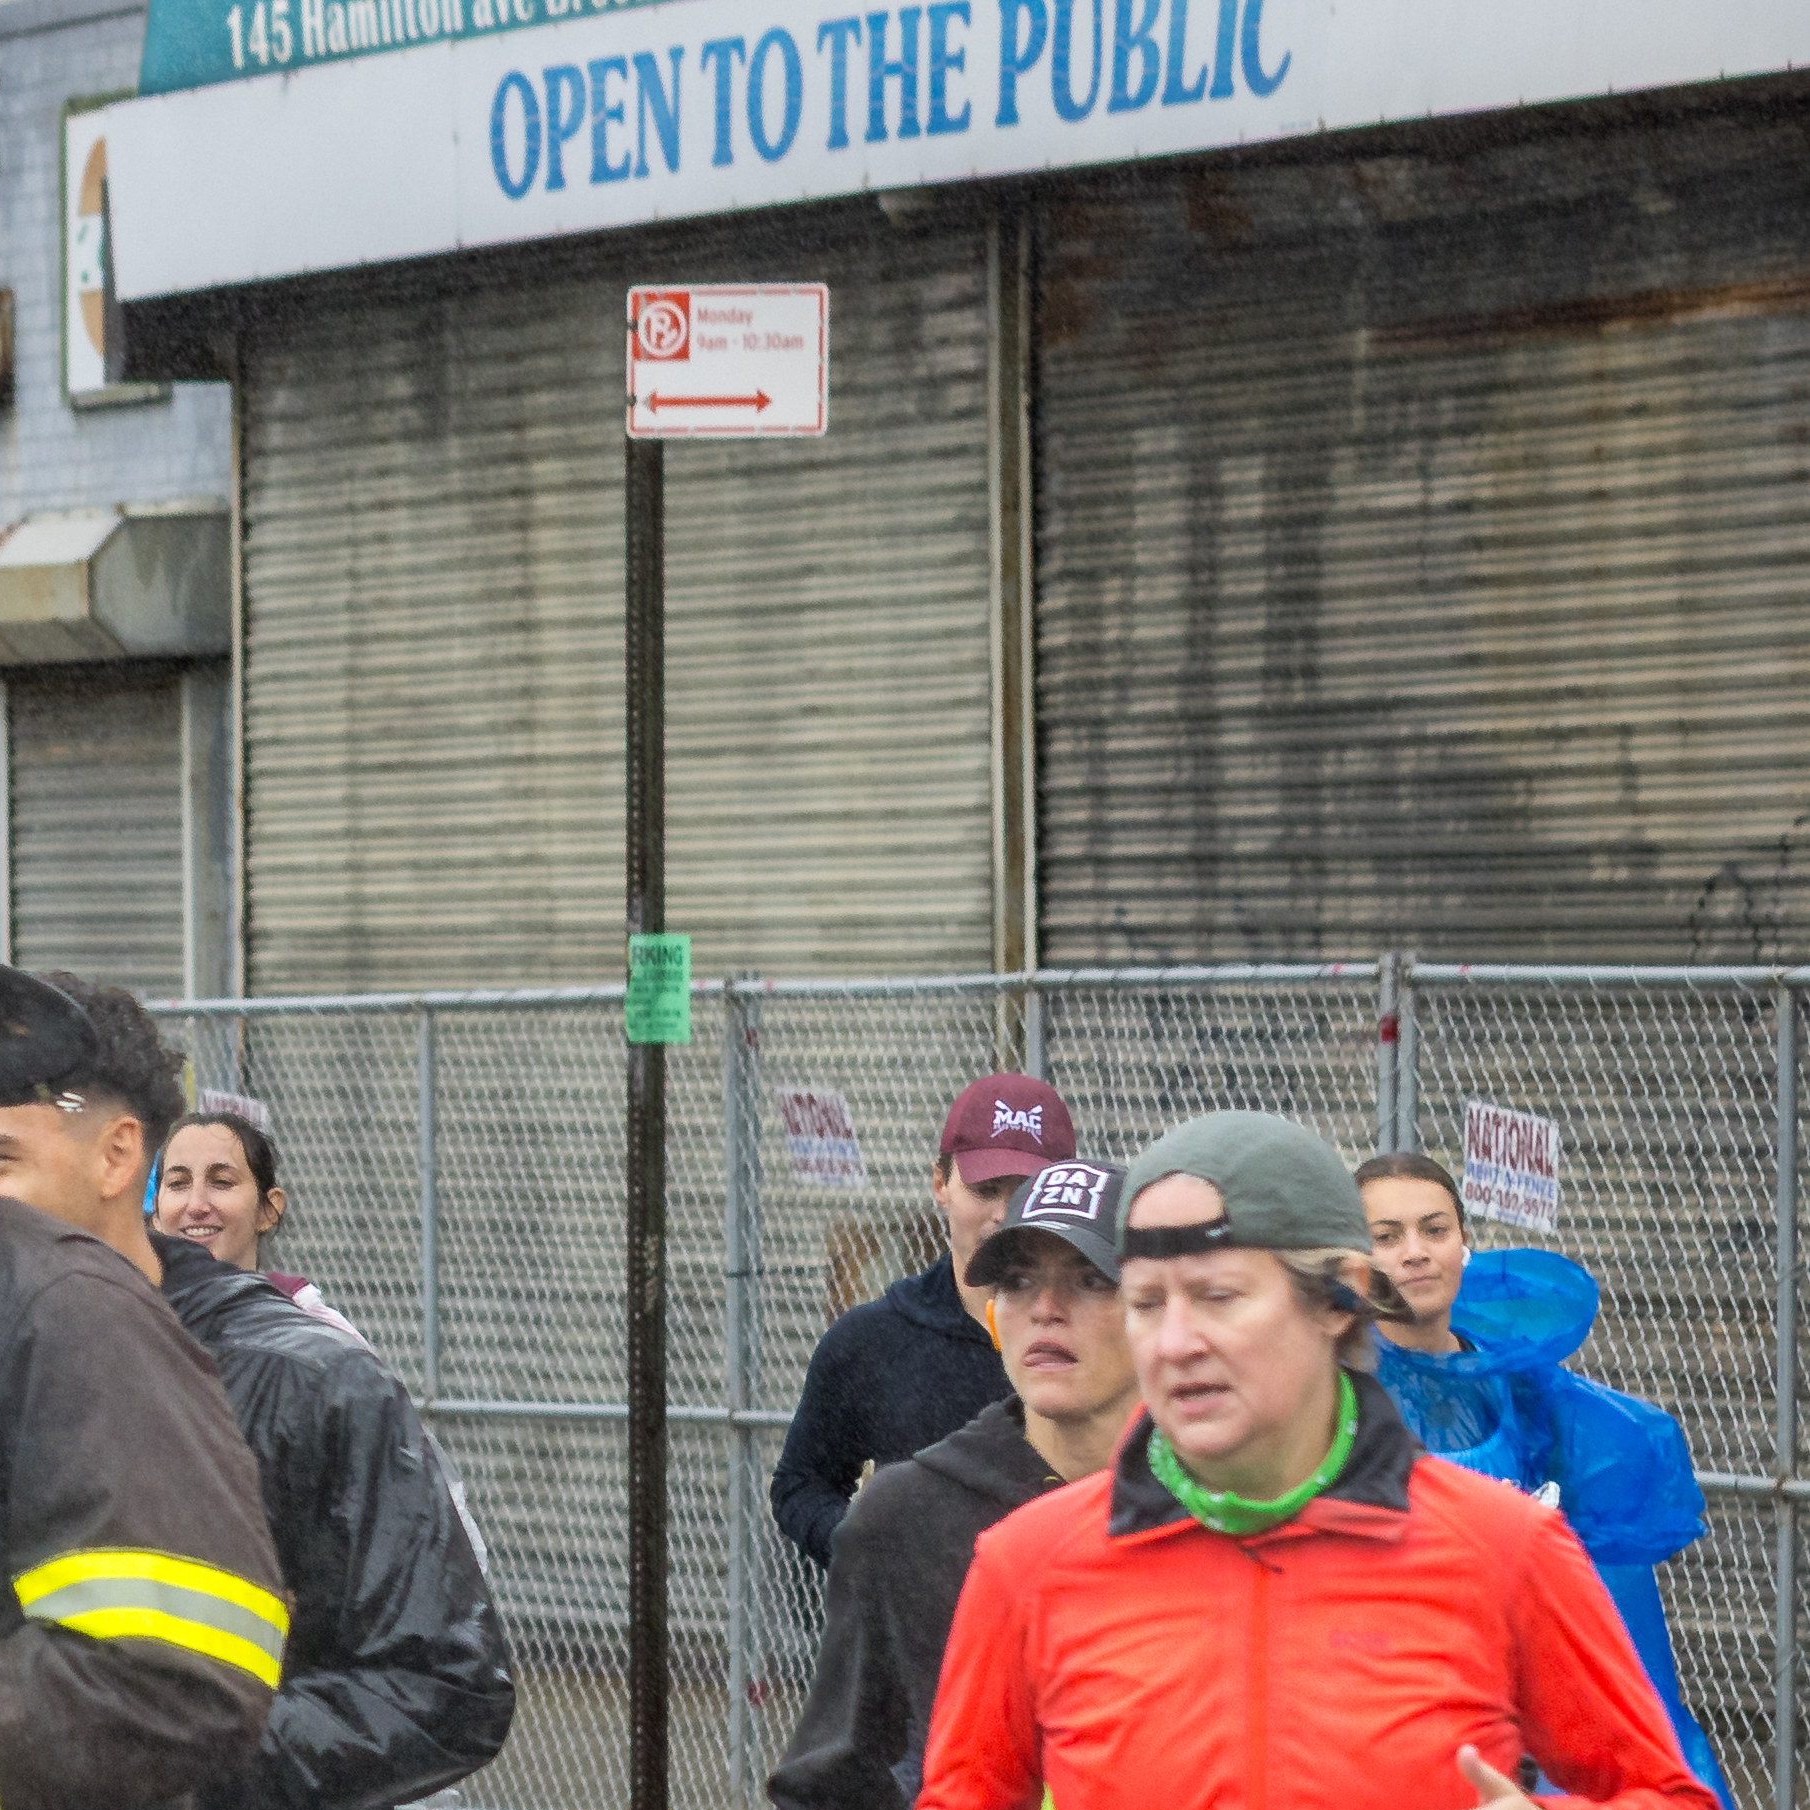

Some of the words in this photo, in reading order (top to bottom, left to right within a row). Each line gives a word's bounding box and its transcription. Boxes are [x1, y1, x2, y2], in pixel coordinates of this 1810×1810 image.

[226, 4, 294, 70] 145
[300, 0, 466, 58] Hamilton
[489, 47, 687, 202] OPEN
[700, 27, 804, 168] TO
[816, 0, 974, 152] THE
[989, 0, 1293, 130] PUBLIC
[697, 307, 754, 328] Monday
[697, 333, 727, 352] 9am
[743, 333, 804, 351] 10:30am
[1467, 1107, 1555, 1179] NATIONAL
[1045, 1170, 1089, 1187] DA
[1039, 1186, 1083, 1206] ZN
